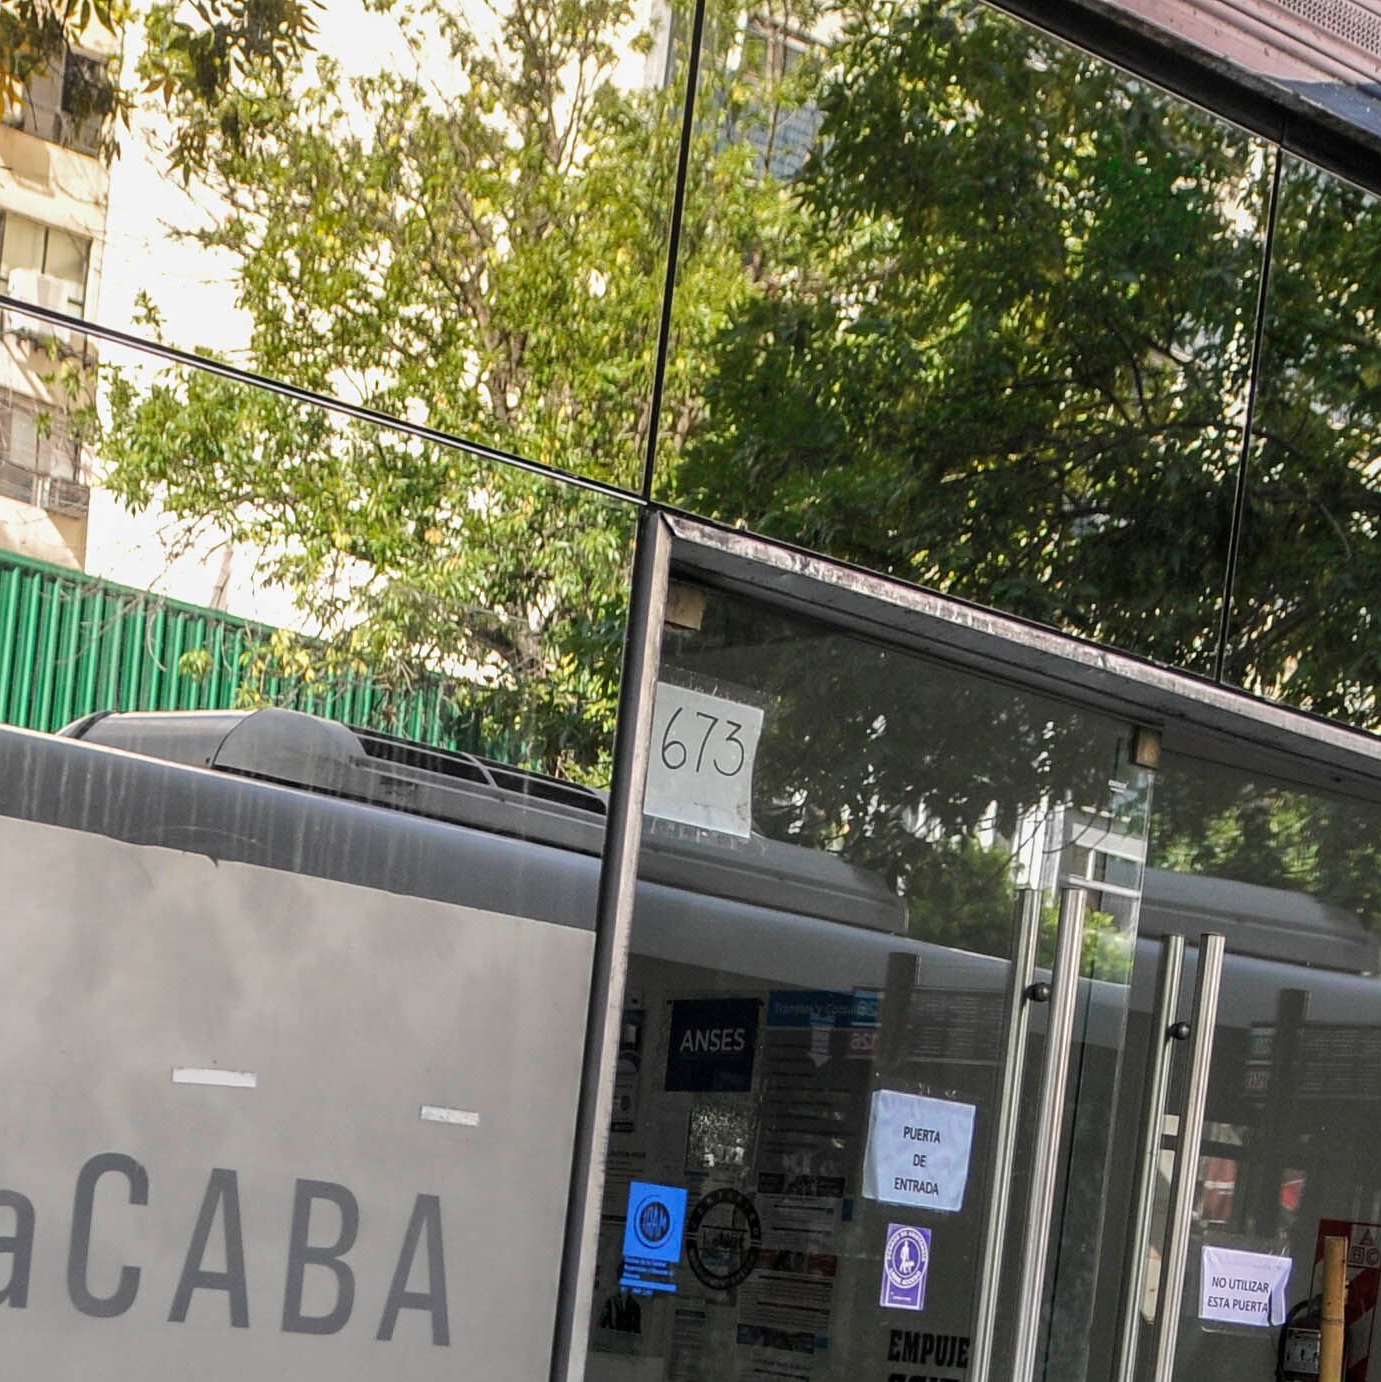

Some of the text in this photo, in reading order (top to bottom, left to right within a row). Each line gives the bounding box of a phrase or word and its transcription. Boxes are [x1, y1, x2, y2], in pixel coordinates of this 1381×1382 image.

[661, 707, 745, 777] 673
[679, 1027, 746, 1053] ANSES
[903, 1125, 941, 1145] PUERTA
[912, 1153, 927, 1168] DE
[894, 1176, 939, 1196] ENTRADA
[1211, 1276, 1270, 1293] NO UTILIZAR
[1207, 1295, 1268, 1313] ESTA PUERTA
[888, 1329, 971, 1369] EMPUJE
